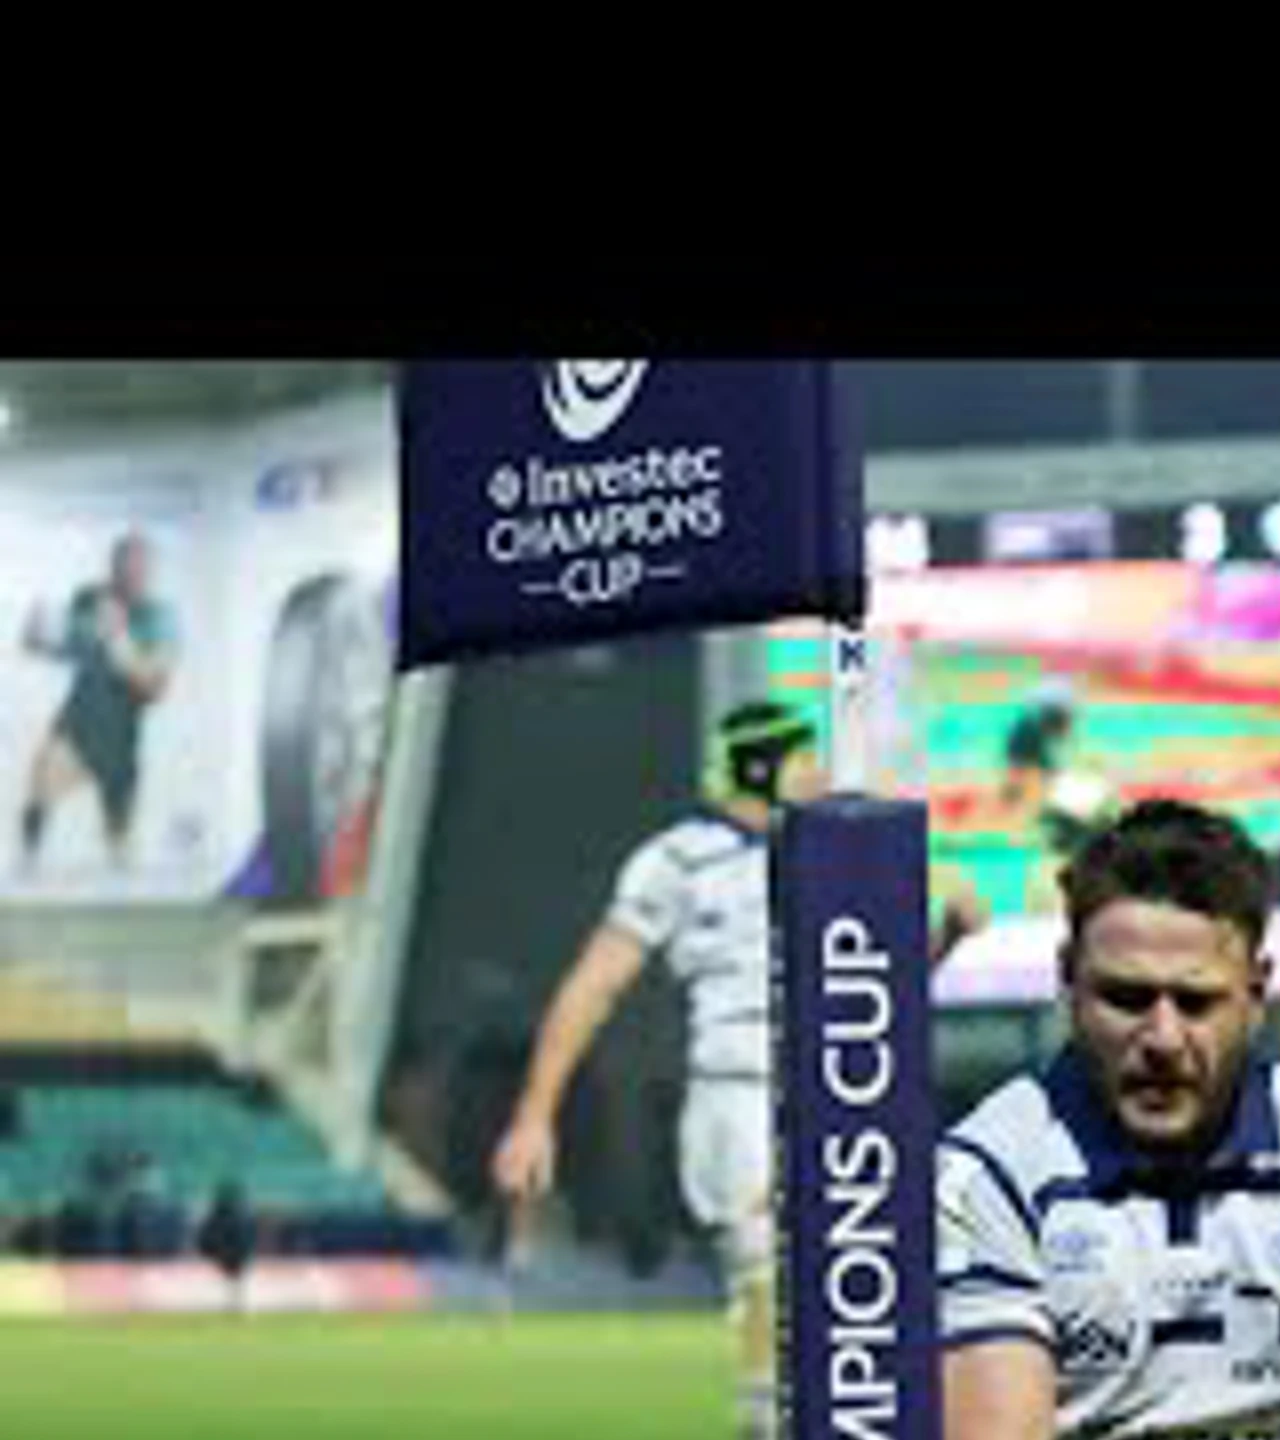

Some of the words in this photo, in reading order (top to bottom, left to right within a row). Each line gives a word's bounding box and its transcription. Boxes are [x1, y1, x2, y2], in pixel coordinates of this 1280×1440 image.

[526, 446, 722, 506] Investec
[487, 488, 722, 562] CHAMPIONS
[559, 554, 643, 603] CUP
[821, 915, 893, 1106] CUP
